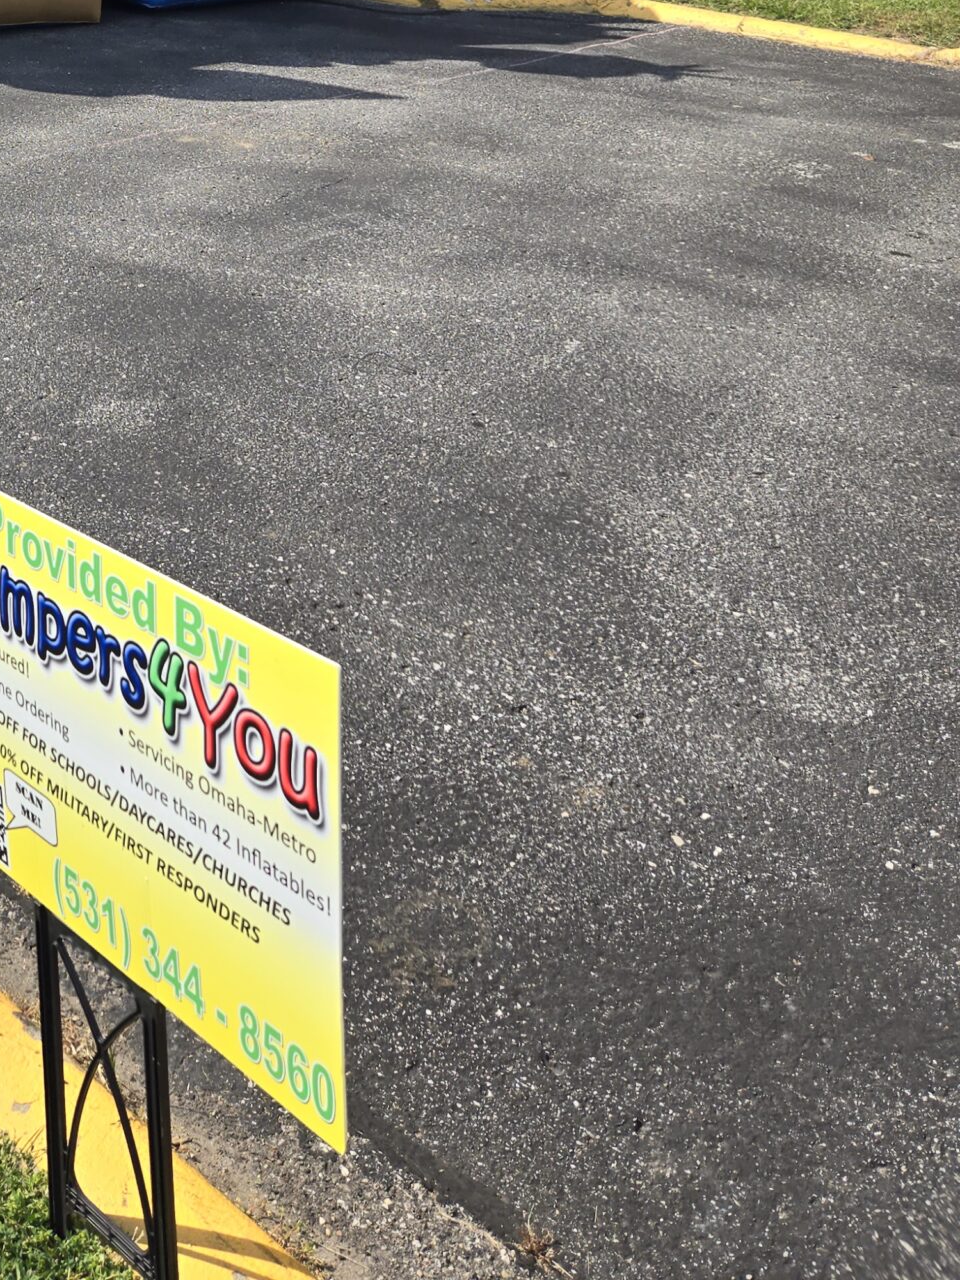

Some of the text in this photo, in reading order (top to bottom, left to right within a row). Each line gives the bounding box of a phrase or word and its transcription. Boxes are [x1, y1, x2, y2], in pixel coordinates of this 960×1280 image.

[174, 595, 250, 687] By:
[15, 690, 71, 743] Ordering
[22, 727, 47, 757] FOR
[15, 781, 43, 811] SCAN
[20, 760, 44, 785] OFF
[46, 779, 154, 865] MILITARY/FIRST
[156, 857, 261, 944] RESPONDERS
[128, 730, 317, 864] Servicing Omaha-Metro
[129, 767, 332, 916] More than 42 Inflatables!
[53, 857, 131, 970] (531)
[141, 927, 206, 1019] 344
[239, 1004, 336, 1124] 8560
